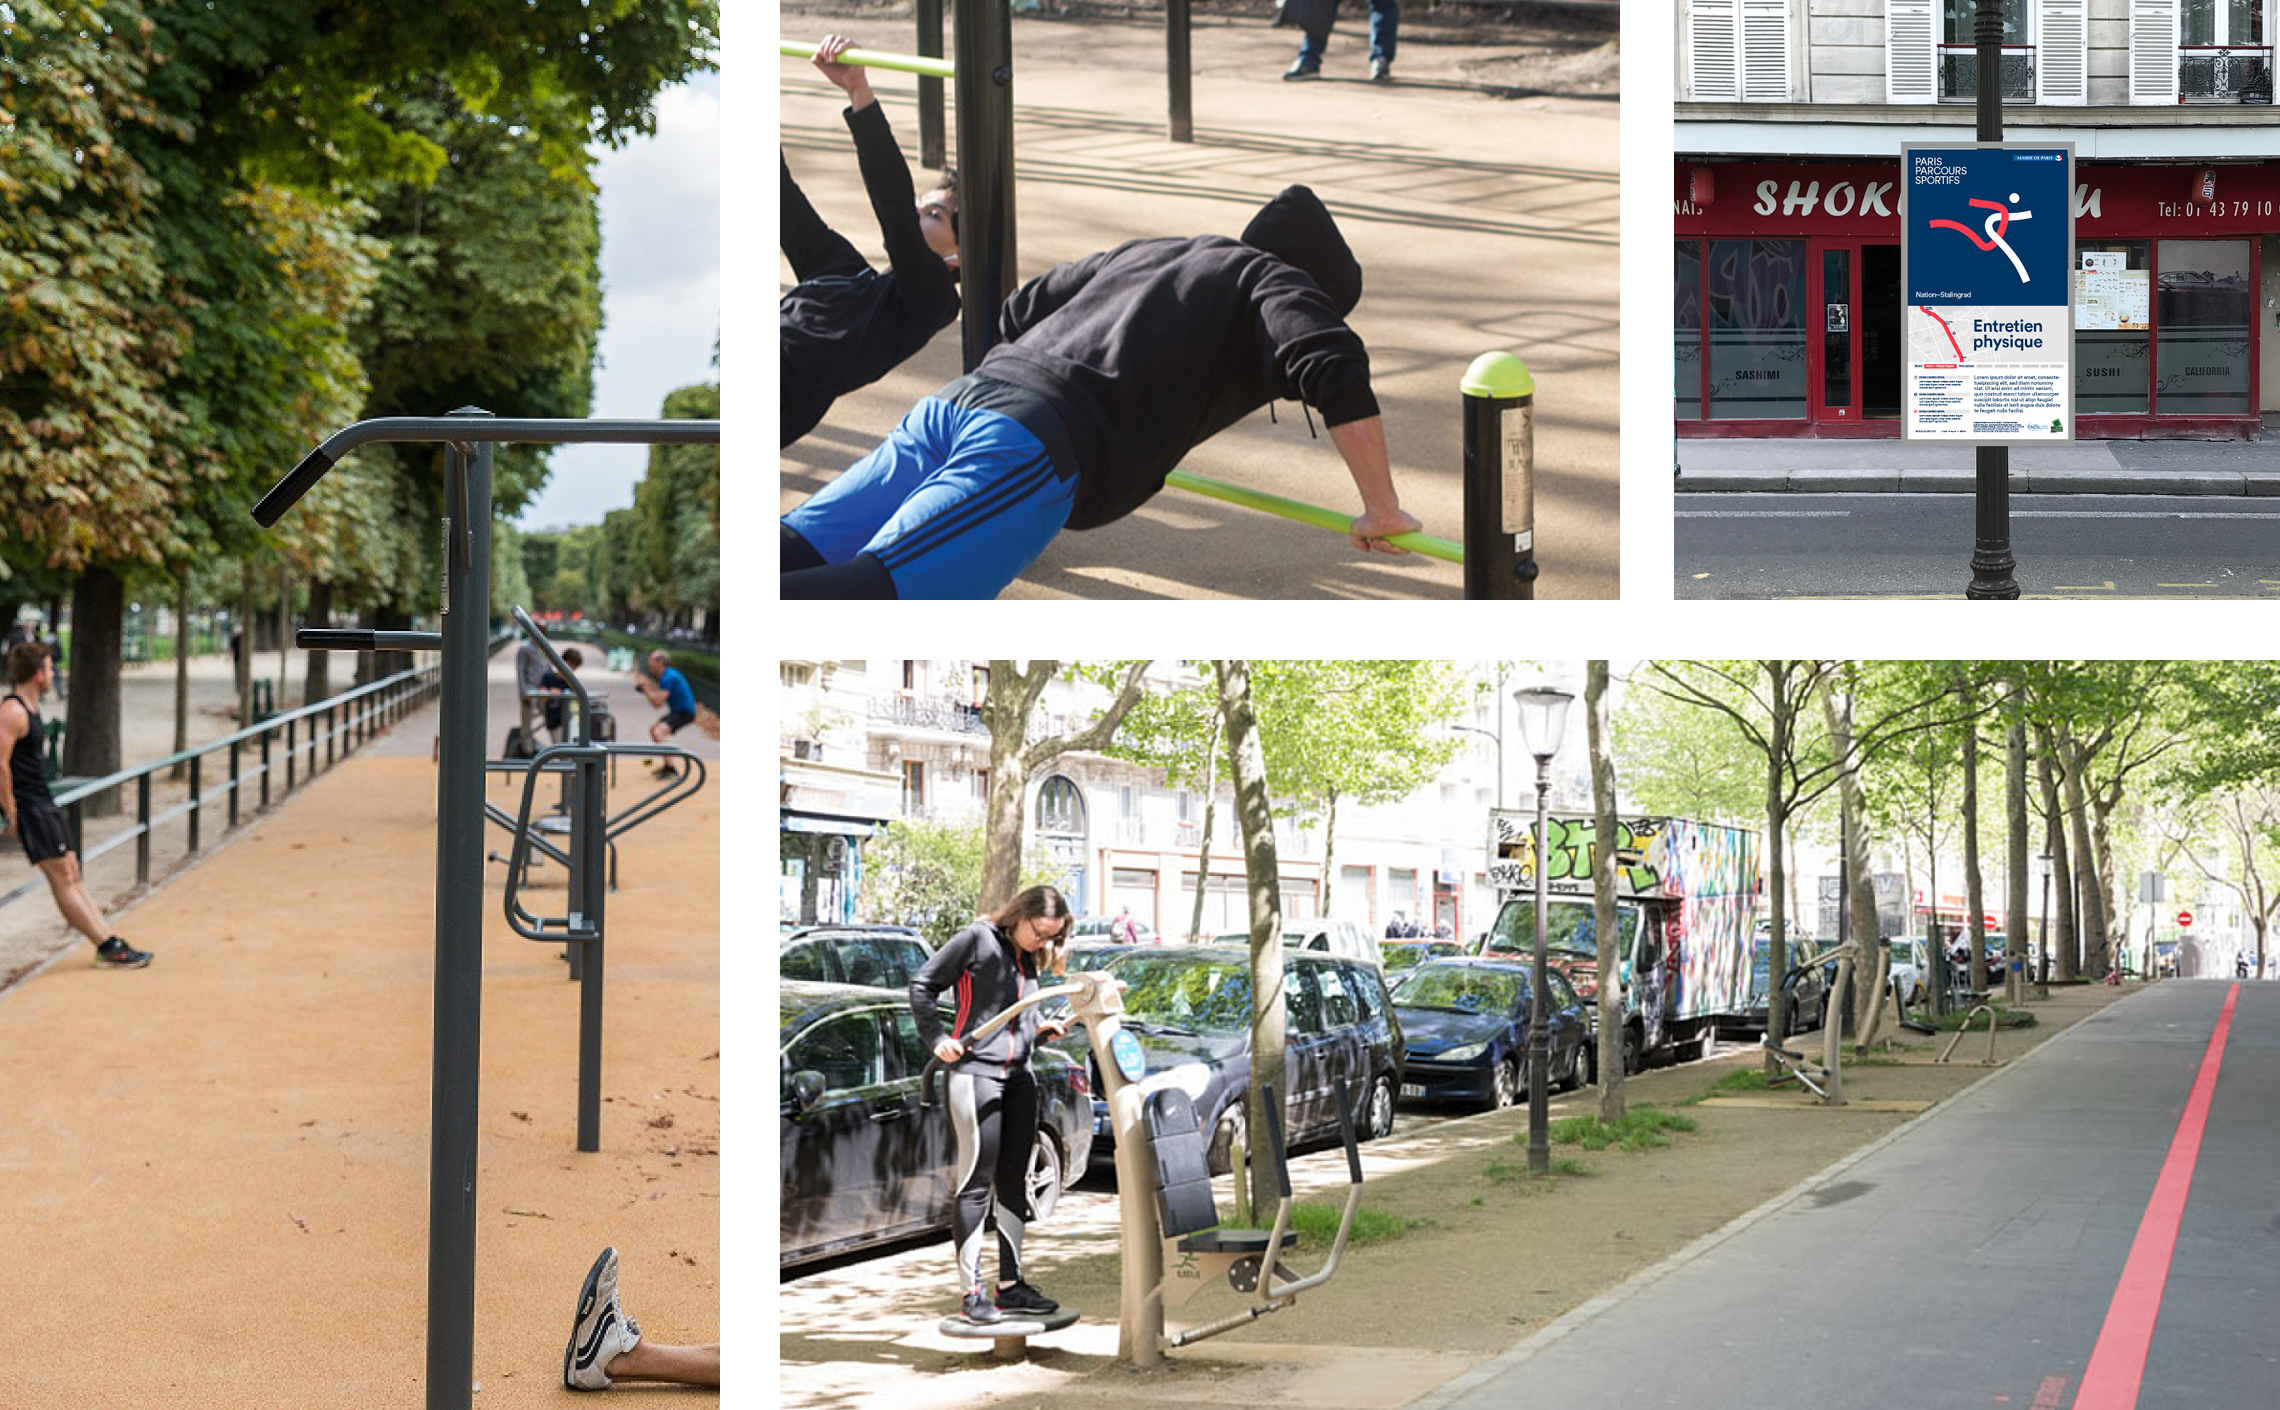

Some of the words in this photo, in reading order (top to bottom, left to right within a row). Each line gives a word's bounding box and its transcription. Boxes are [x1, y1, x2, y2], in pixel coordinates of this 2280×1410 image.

[1915, 157, 1942, 166] PARIS
[1915, 166, 1967, 175] PARCOURS
[1915, 175, 1960, 185] SPORTIFS
[1753, 179, 1901, 217] SHOK
[2158, 201, 2181, 217] Tel:
[2186, 202, 2200, 217] 01
[2209, 201, 2225, 217] 43
[2233, 201, 2249, 217] 79
[2257, 200, 2272, 216] 10
[1973, 319, 2043, 333] Entretien
[1973, 334, 2043, 351] physique
[1735, 370, 1780, 380] SASHIMI
[2086, 367, 2120, 377] SUSHI
[2185, 366, 2230, 376] CALIFORNIA
